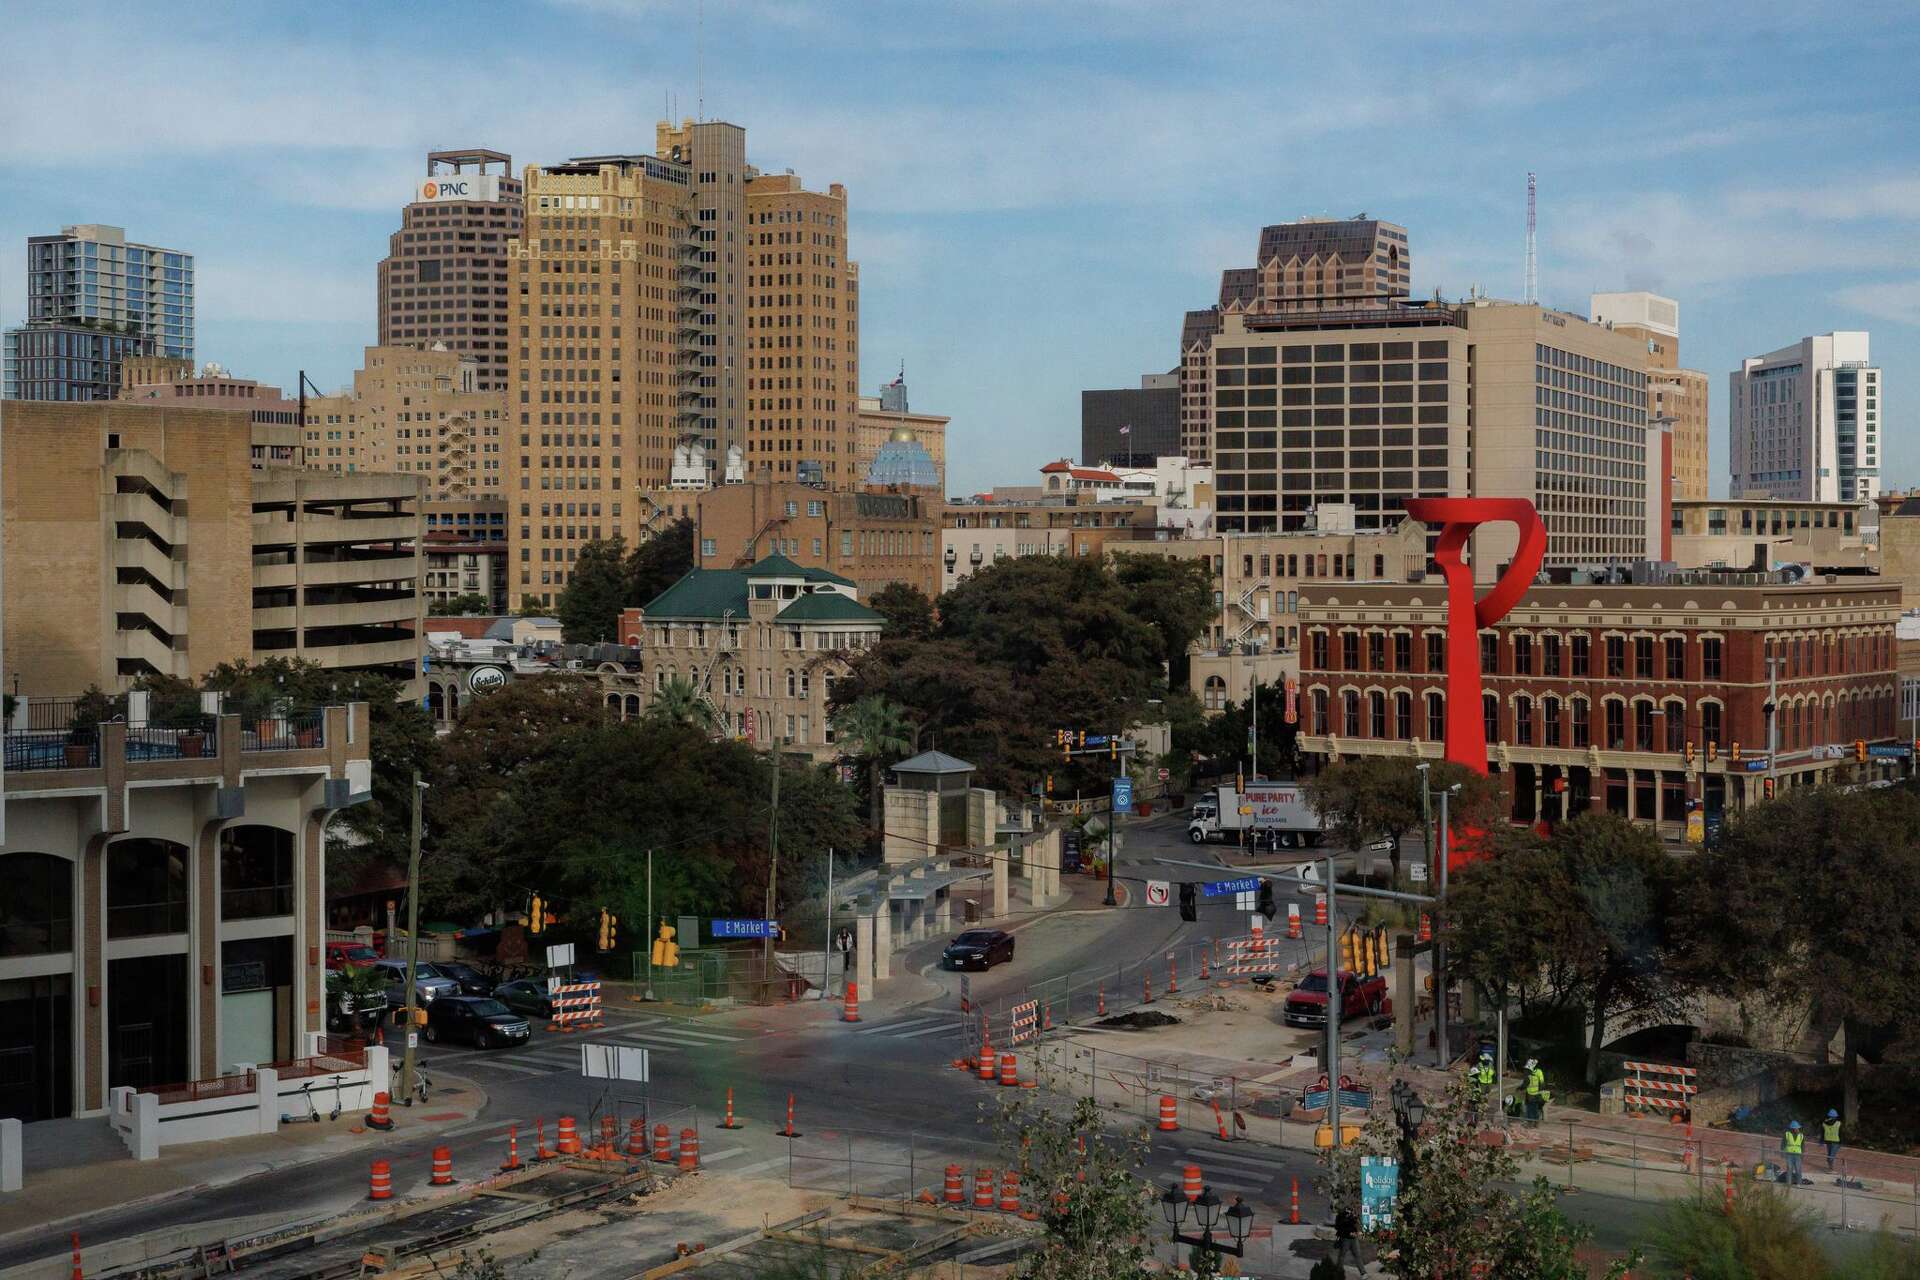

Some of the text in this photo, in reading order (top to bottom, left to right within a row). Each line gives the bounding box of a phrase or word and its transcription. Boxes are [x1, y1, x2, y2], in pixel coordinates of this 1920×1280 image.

[440, 182, 468, 197] PNC
[1245, 792, 1296, 803] PURE PARTY
[1262, 804, 1279, 815] ice
[1216, 879, 1255, 893] E Market
[725, 921, 731, 934] E
[733, 921, 764, 934] Market
